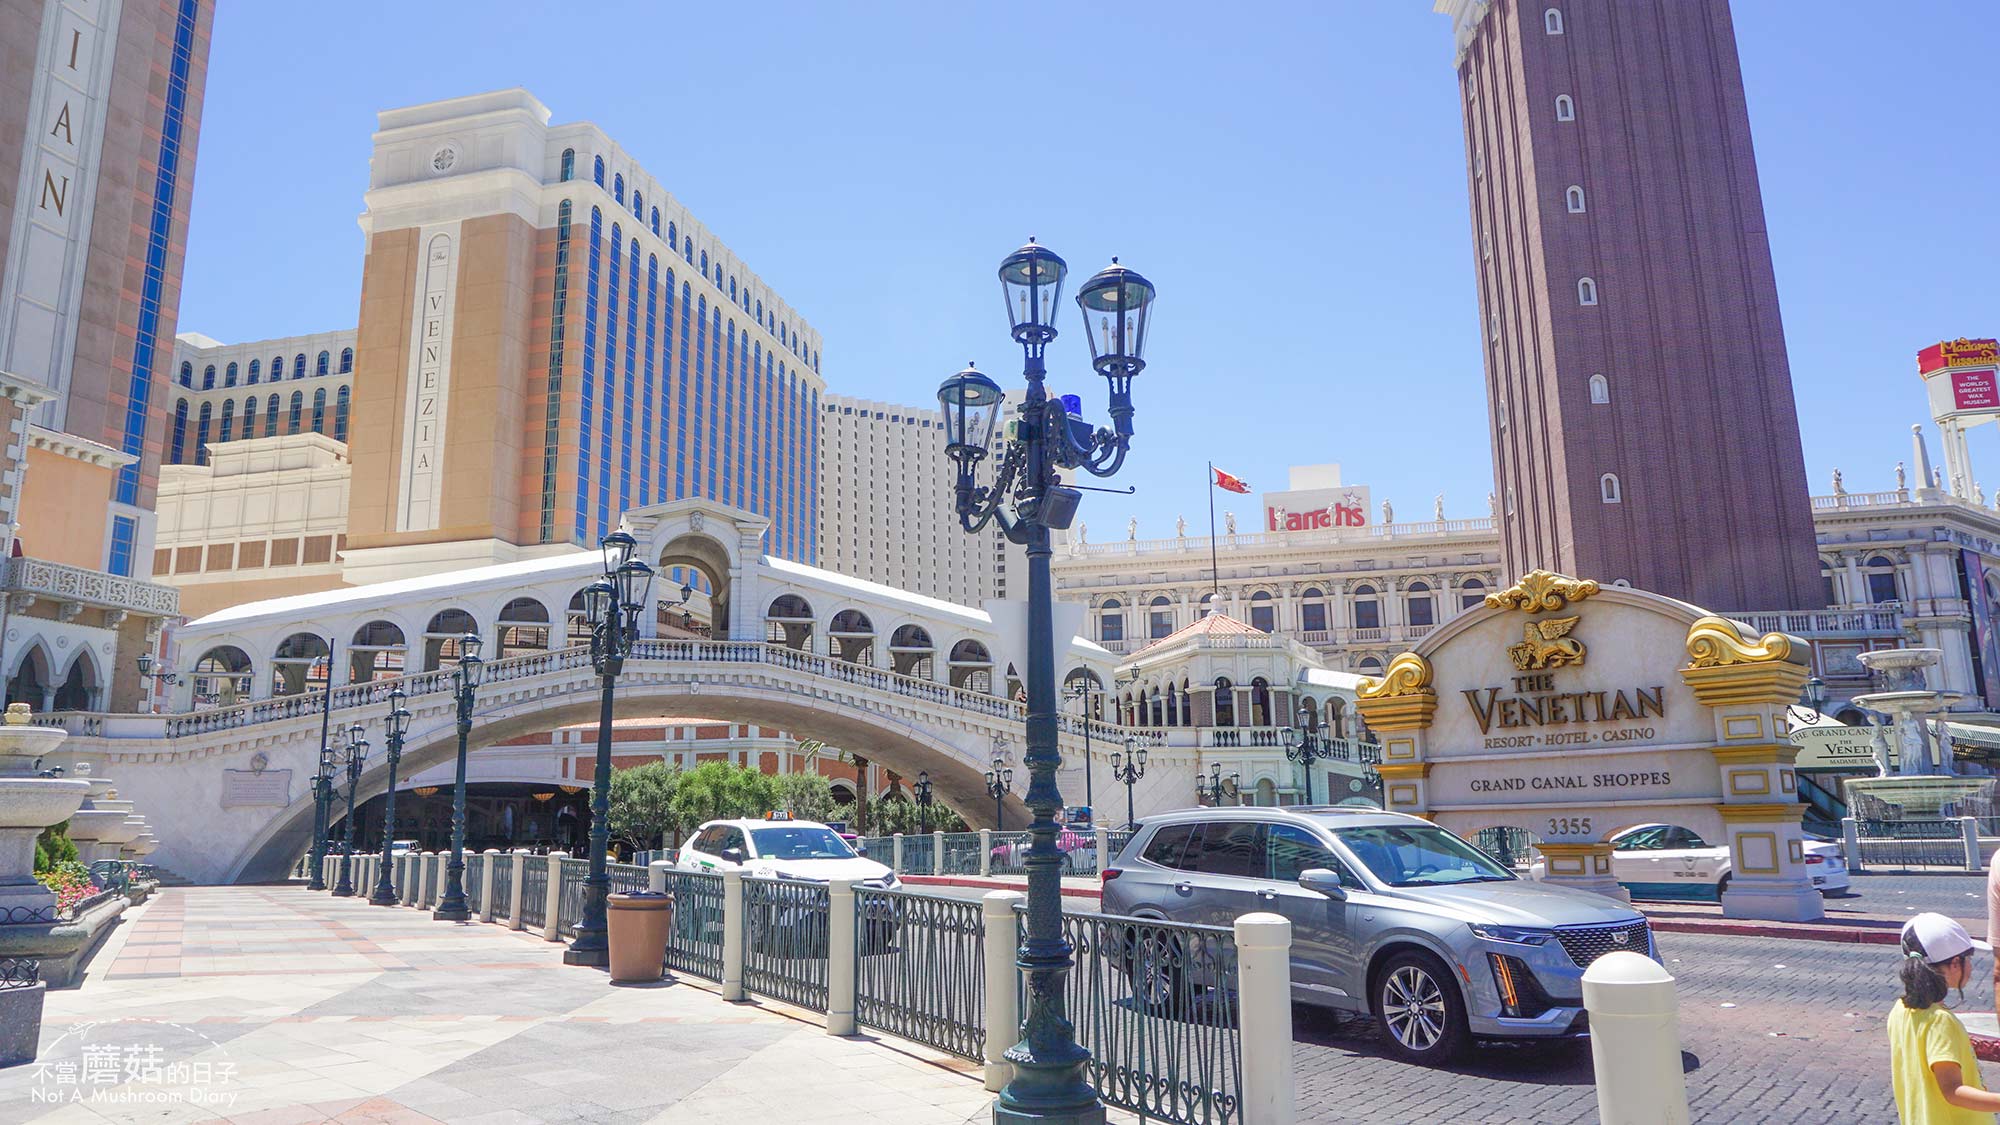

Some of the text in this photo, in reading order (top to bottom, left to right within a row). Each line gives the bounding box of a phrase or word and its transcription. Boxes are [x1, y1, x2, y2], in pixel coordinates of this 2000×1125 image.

[38, 0, 88, 217] IAN
[1940, 337, 1996, 354] Madame
[1940, 350, 2000, 368] Tussauds
[418, 295, 442, 468] VENEZIA
[1511, 674, 1555, 693] THE
[1460, 686, 1665, 735] VENETIAN
[1484, 727, 1655, 749] RESORT HOTEL CASINO
[1790, 728, 1872, 744] THE GRAND CAN
[1825, 743, 1892, 755] VENETIN
[1470, 772, 1671, 792] GRAND CANAL SHOPPES
[1548, 818, 1592, 835] 3355
